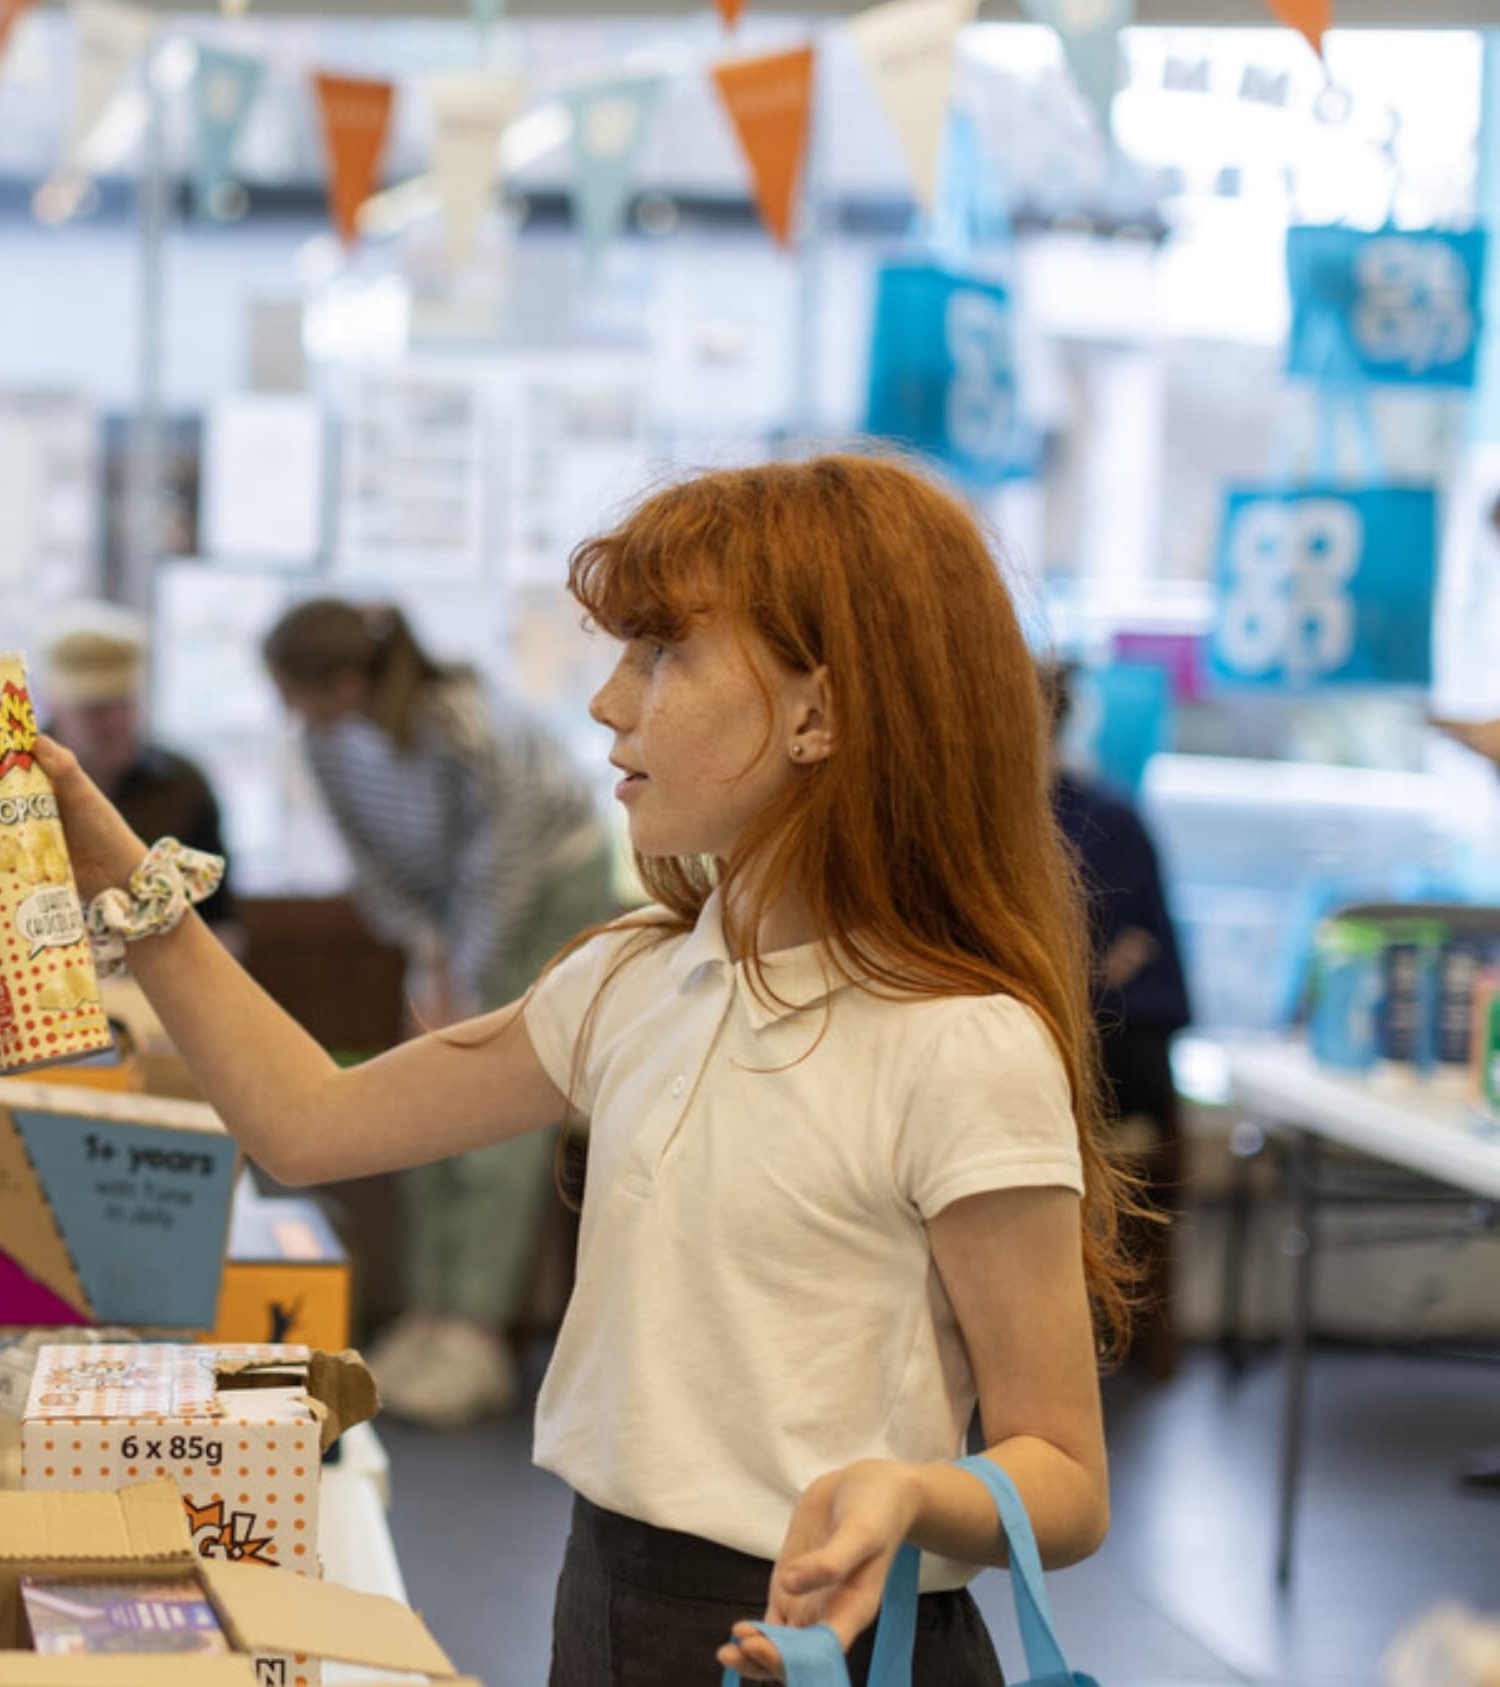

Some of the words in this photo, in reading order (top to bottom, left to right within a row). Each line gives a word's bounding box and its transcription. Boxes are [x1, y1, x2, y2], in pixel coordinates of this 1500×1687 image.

[127, 1145, 215, 1179] years
[121, 1435, 139, 1460] 6
[145, 1441, 162, 1459] x
[169, 1435, 223, 1467] 85g
